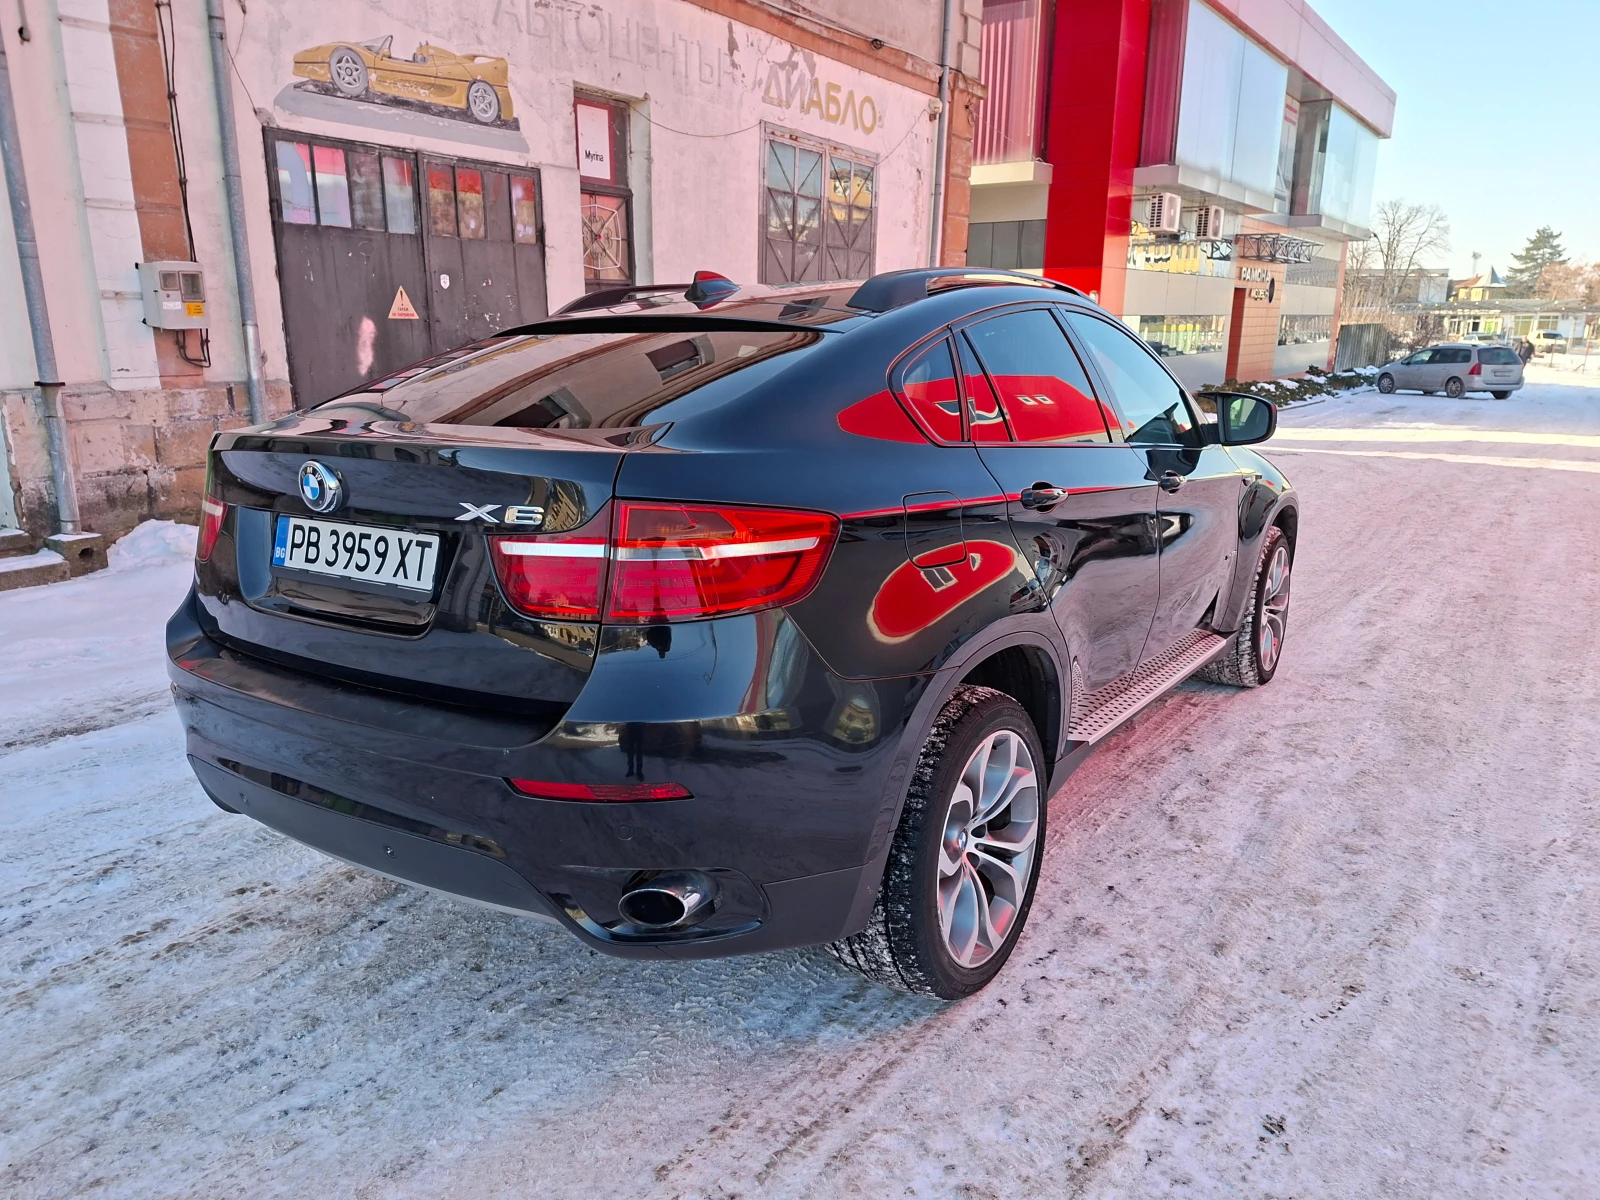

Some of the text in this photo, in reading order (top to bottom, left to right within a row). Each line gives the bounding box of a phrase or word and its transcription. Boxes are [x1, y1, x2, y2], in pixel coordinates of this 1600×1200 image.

[762, 63, 877, 135] ДИАБЛО
[454, 502, 544, 526] X6
[275, 546, 286, 559] BG
[289, 524, 433, 582] PB 3959 XT
